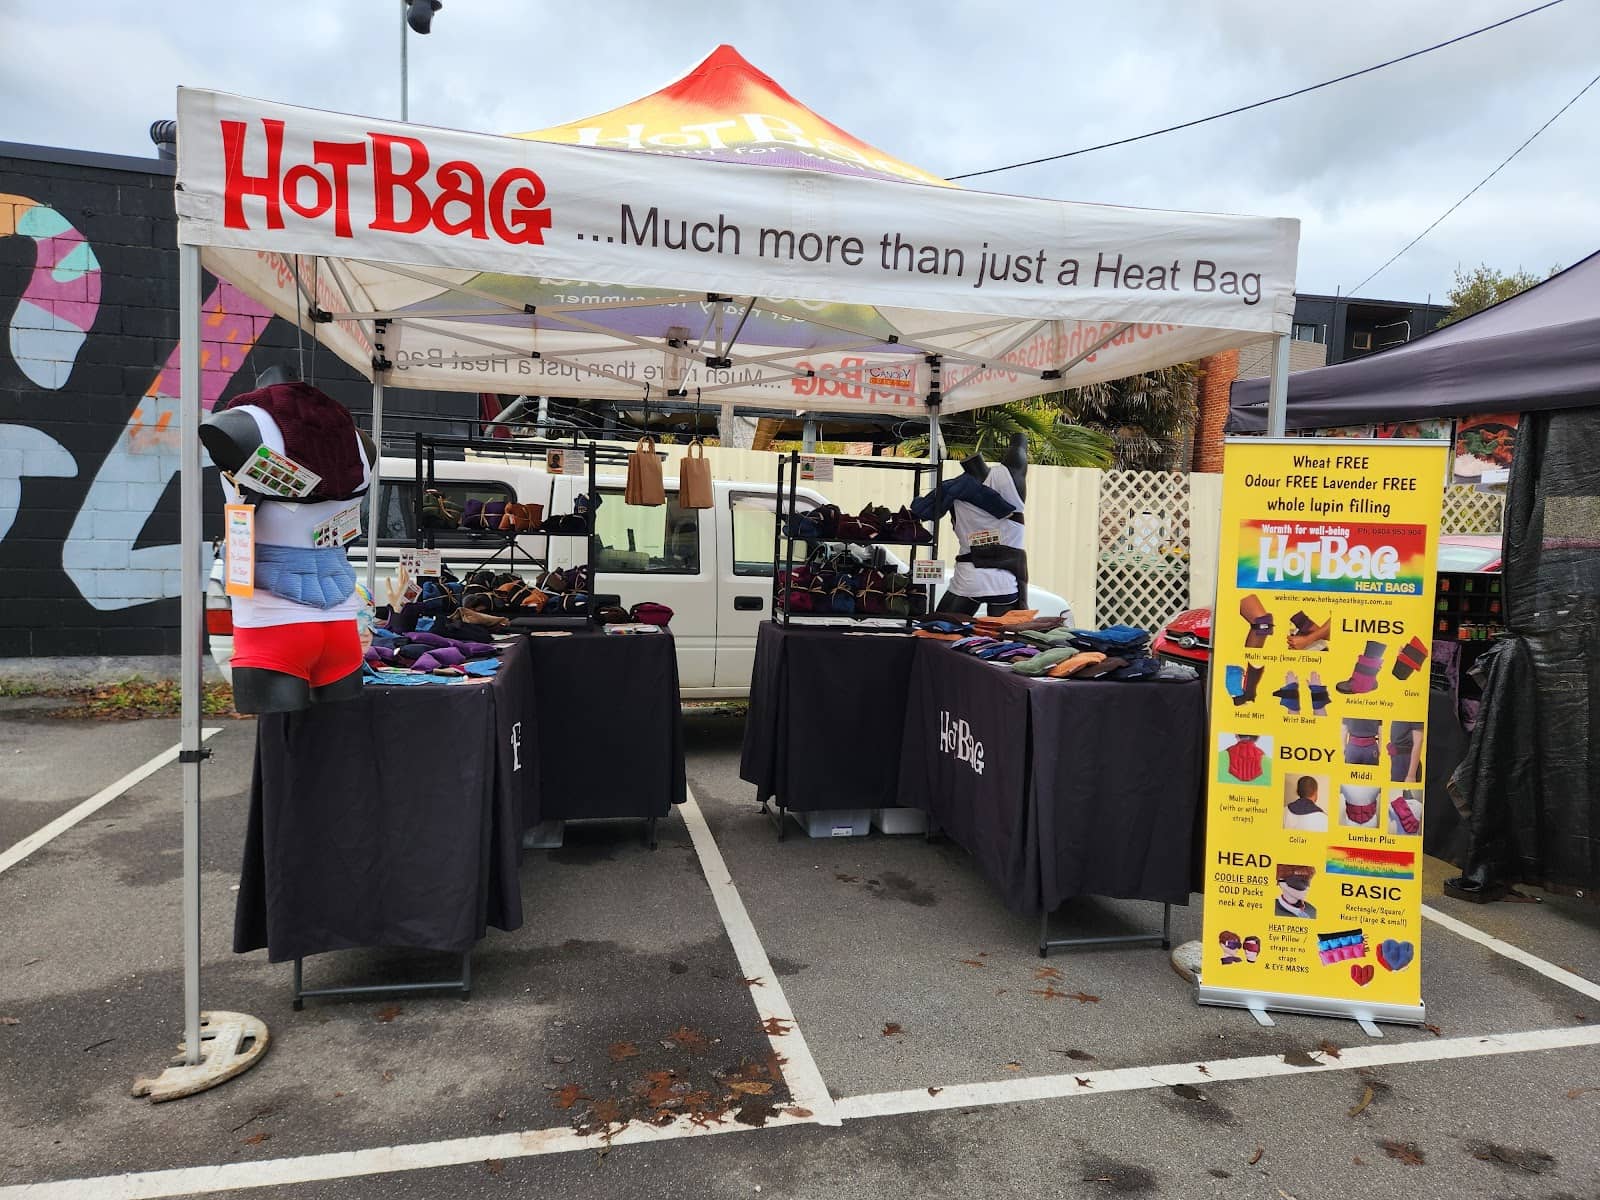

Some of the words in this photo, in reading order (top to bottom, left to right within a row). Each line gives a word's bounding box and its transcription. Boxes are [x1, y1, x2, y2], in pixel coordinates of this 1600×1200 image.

[759, 226, 864, 267] more
[880, 233, 964, 277] than
[974, 242, 1047, 289] just
[1057, 258, 1080, 286] a
[1094, 252, 1181, 292] Heat
[1193, 260, 1262, 305] Bag
[1293, 455, 1331, 469] Wheat
[1336, 456, 1369, 470] FREE
[1245, 474, 1281, 488] Odour
[1285, 475, 1318, 489] FREE
[1323, 476, 1378, 490] Lavender
[1382, 477, 1417, 491] FREE
[1267, 497, 1305, 511] whole
[1310, 497, 1344, 516] lupin
[1349, 498, 1391, 518] filling
[1261, 523, 1292, 534] Warmth
[1295, 524, 1308, 535] for
[1309, 525, 1350, 538] well-being
[1355, 581, 1383, 592] HEAT
[1385, 582, 1416, 593] BAGS
[1342, 618, 1405, 634] LIMBS
[1244, 652, 1261, 660] Multi
[1262, 655, 1278, 663] wrap
[1404, 689, 1420, 697] Glove
[1379, 699, 1394, 708] Wrap
[1234, 711, 1251, 720] Hand
[1251, 712, 1265, 720] Mitt
[1283, 716, 1299, 724] Wrist
[1300, 717, 1316, 725] Band
[1280, 746, 1336, 762] BODY
[1350, 771, 1373, 780] Middi
[1228, 794, 1246, 802] Multi
[1247, 795, 1260, 804] Hug
[1219, 803, 1236, 812] (with
[1245, 806, 1268, 814] without
[1232, 815, 1254, 824] straps)
[1289, 836, 1307, 844] Collar
[1348, 833, 1376, 843] Lumbar
[1379, 835, 1396, 844] Plus
[1218, 851, 1272, 868] HEAD
[1214, 872, 1245, 883] COOLIE
[1246, 875, 1269, 885] BAGS
[1218, 885, 1240, 895] COLD
[1242, 887, 1264, 897] Packs
[1341, 882, 1402, 901] BASIC
[1218, 898, 1235, 906] neck
[1238, 899, 1245, 908] &
[1246, 902, 1263, 910] eyes
[1340, 913, 1358, 921] Heart
[1359, 915, 1379, 925] (large
[1380, 917, 1386, 925] &
[1387, 918, 1407, 928] small)
[1268, 923, 1287, 932] HEAT
[1287, 925, 1309, 934] PACKS
[1268, 933, 1280, 941] Eye
[1281, 934, 1300, 943] Pillow
[1270, 945, 1289, 954] straps
[1278, 955, 1297, 963] straps
[1272, 963, 1284, 971] EYE
[1285, 965, 1310, 974] MASKS
